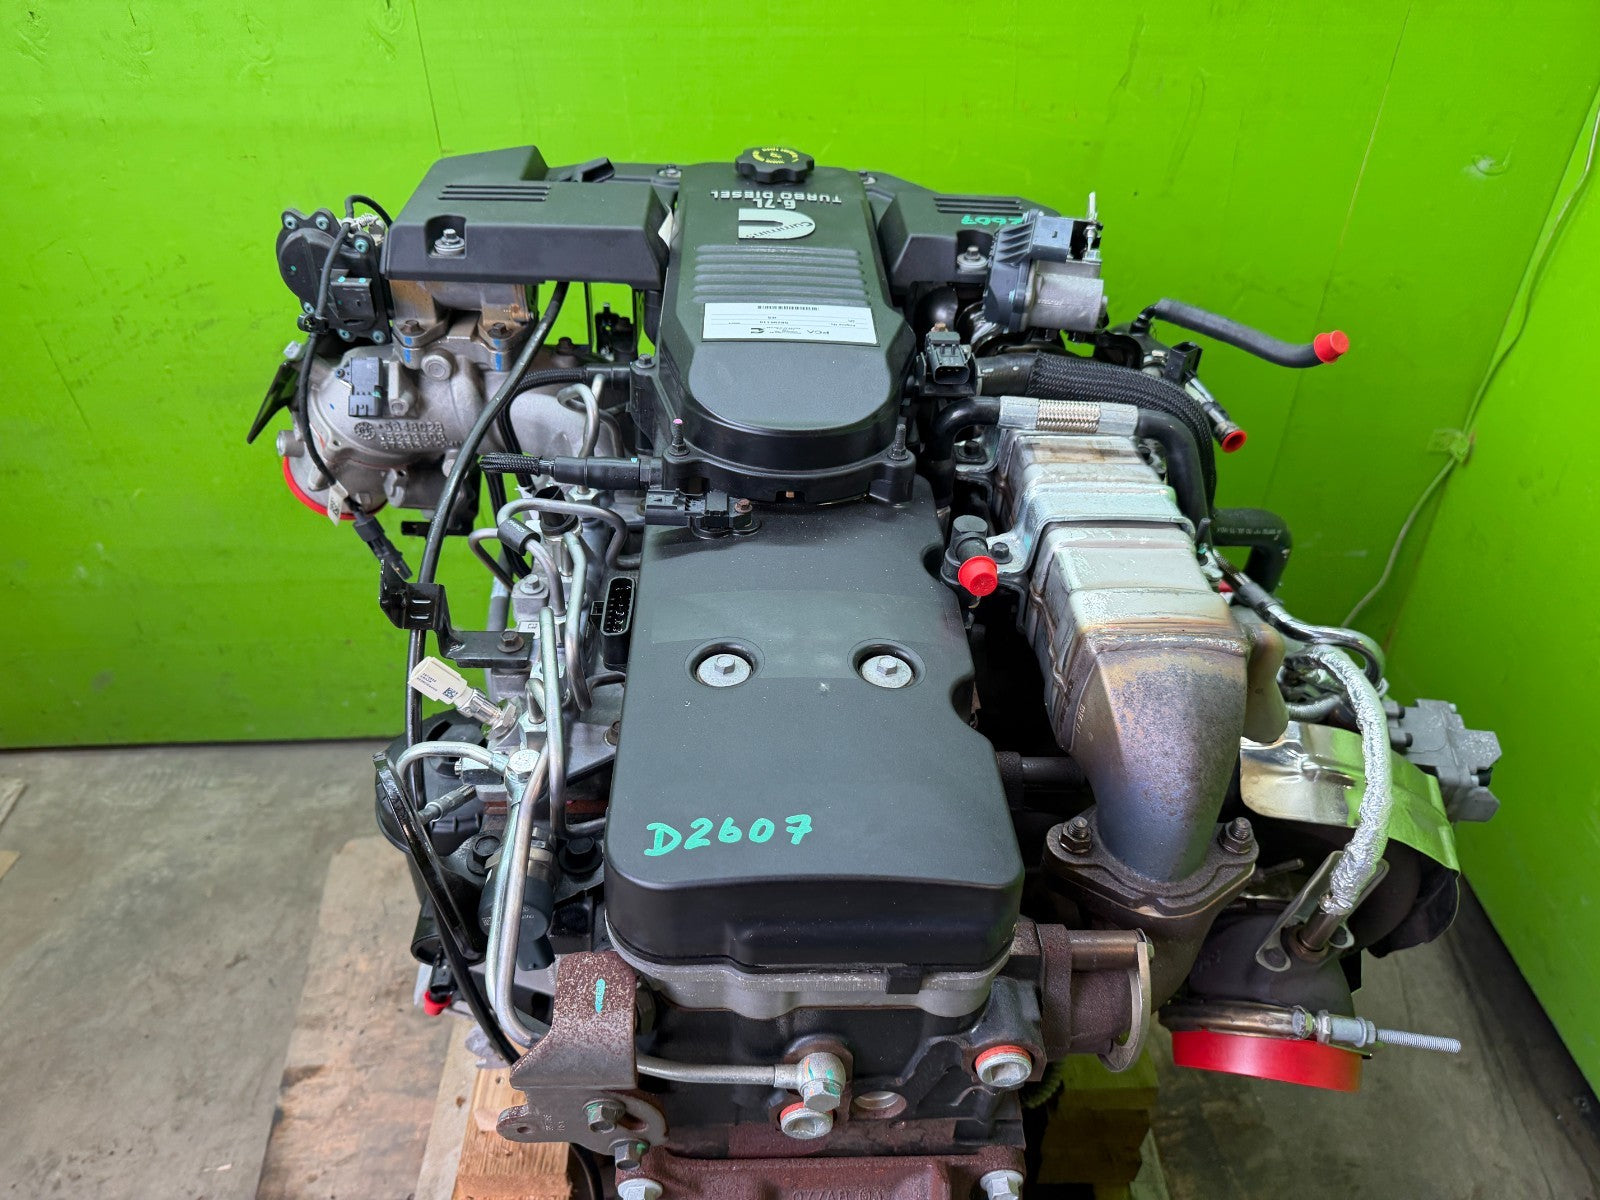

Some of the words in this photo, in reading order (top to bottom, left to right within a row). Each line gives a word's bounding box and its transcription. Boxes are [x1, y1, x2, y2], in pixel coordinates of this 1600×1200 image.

[710, 190, 773, 199] DIESEL
[780, 191, 842, 203] TURBO
[752, 198, 796, 209] 6.7L
[644, 814, 813, 857] D2607
